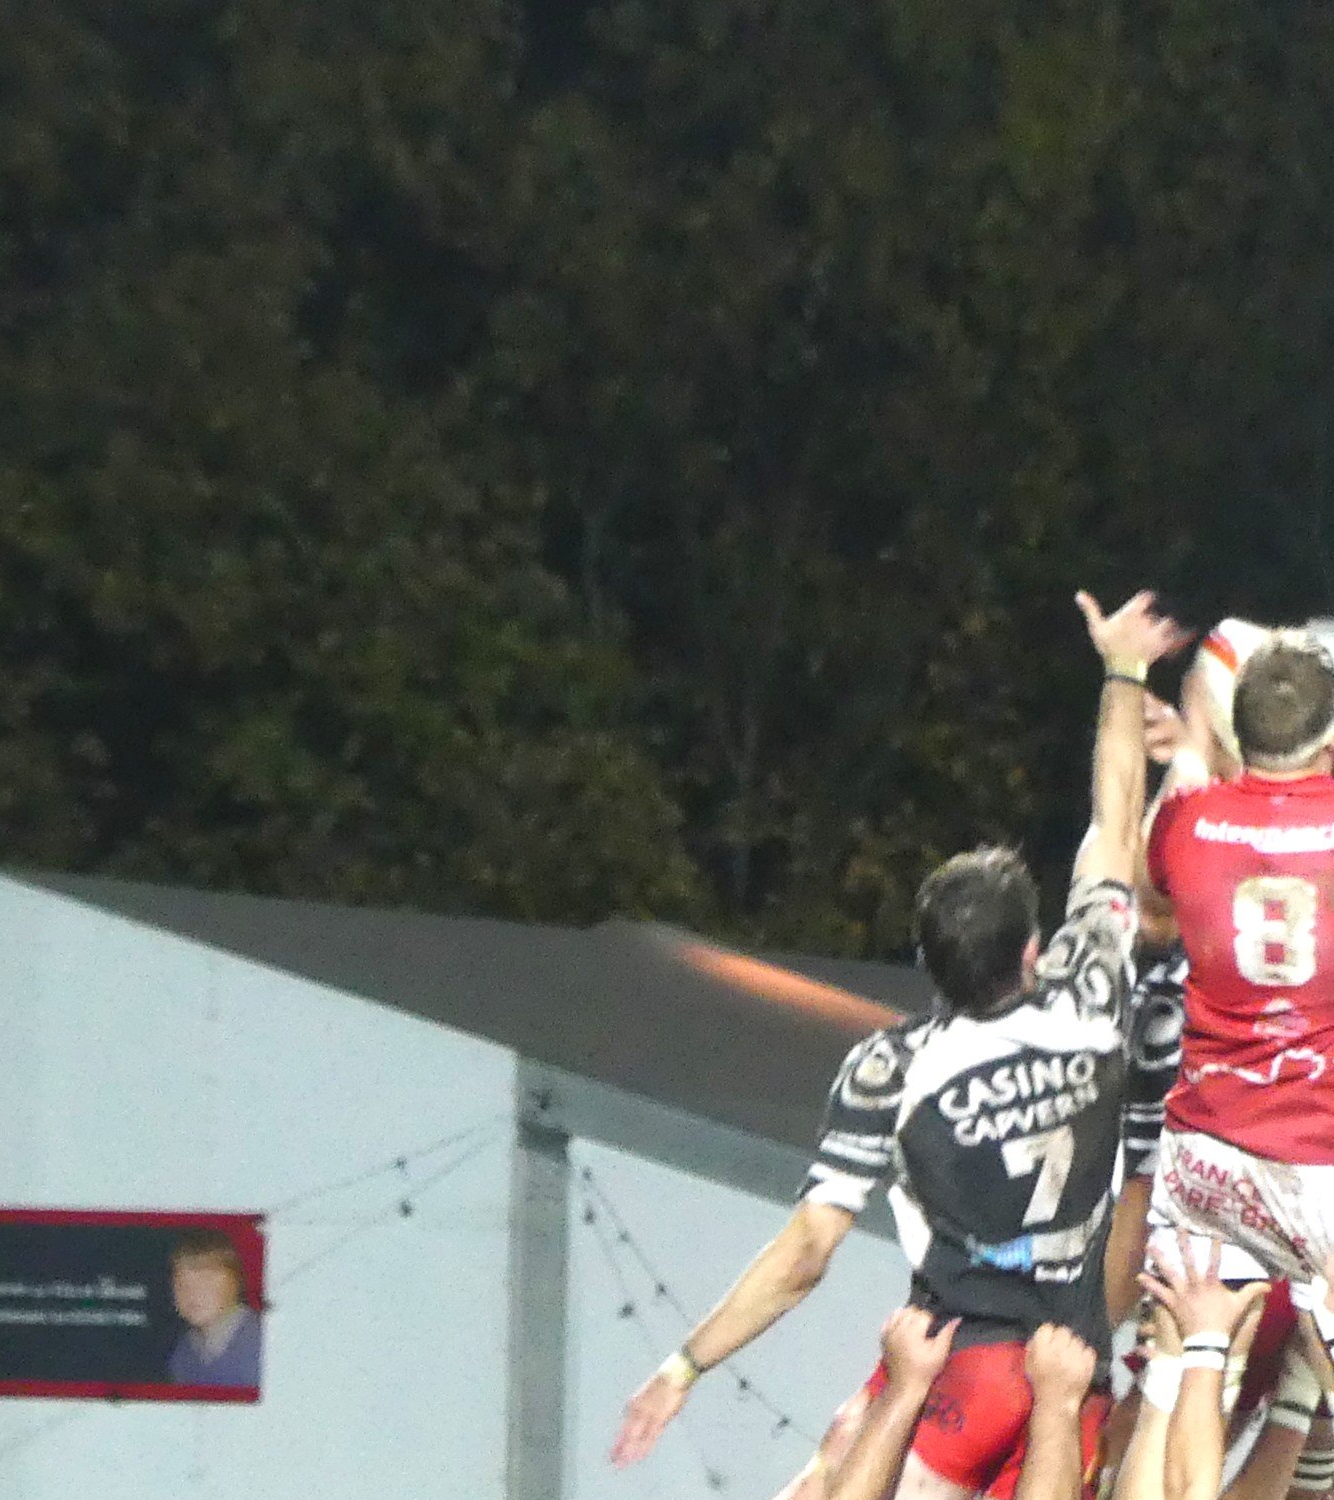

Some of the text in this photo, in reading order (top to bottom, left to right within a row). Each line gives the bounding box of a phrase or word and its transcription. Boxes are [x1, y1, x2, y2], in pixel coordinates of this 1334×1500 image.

[1233, 876, 1317, 987] 8
[938, 1052, 1096, 1121] CASINO
[1000, 1124, 1075, 1227] 7
